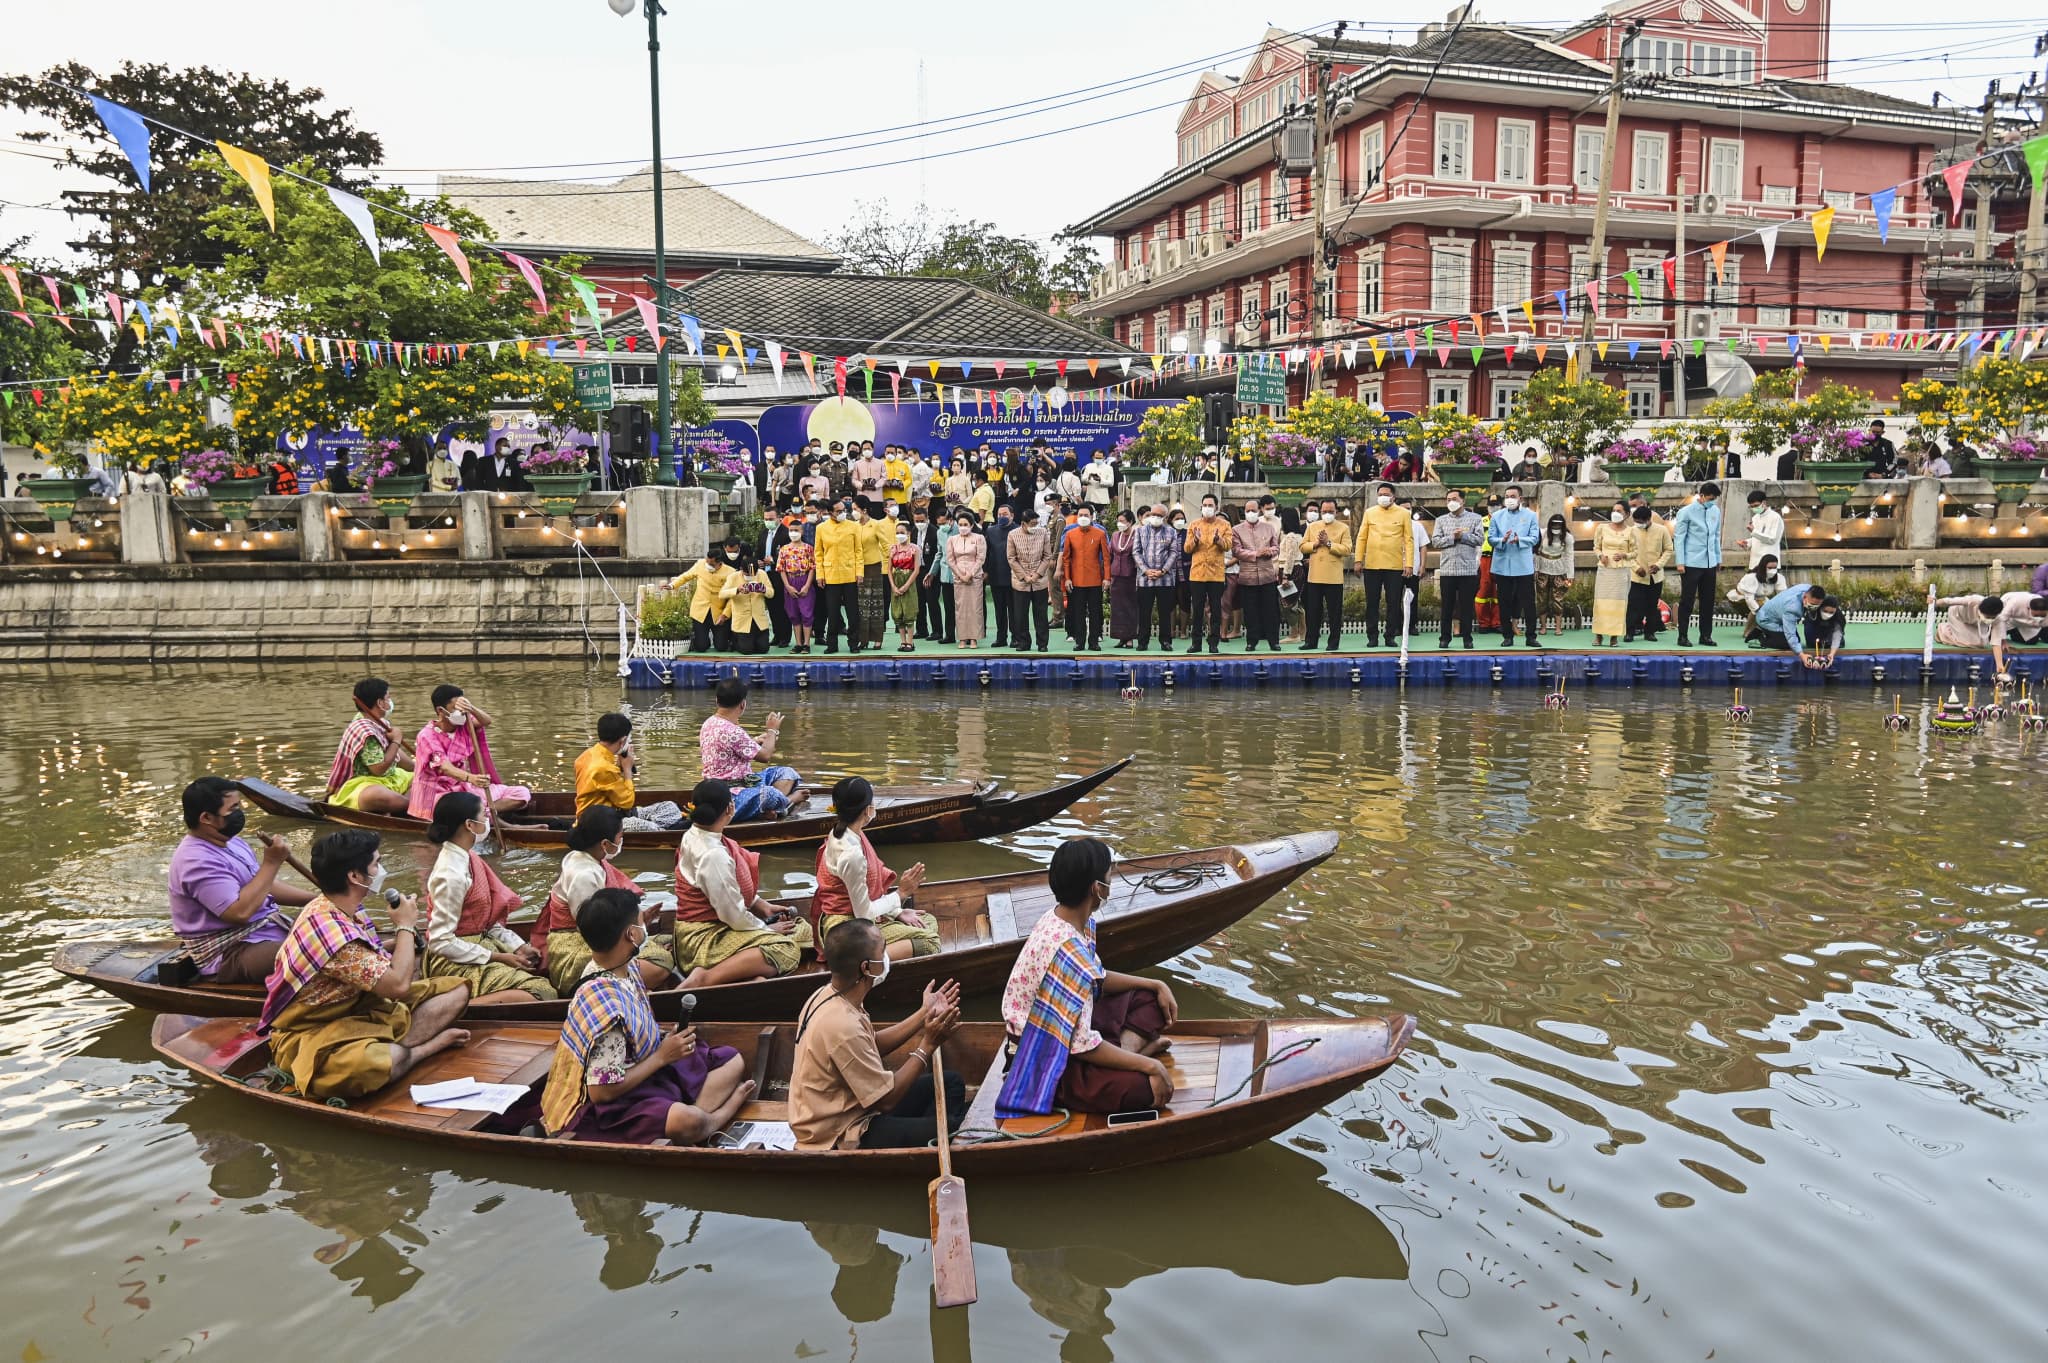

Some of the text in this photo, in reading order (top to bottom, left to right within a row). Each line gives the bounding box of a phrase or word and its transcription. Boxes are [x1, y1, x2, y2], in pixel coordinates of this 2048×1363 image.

[1266, 387, 1284, 395] 19.30
[932, 409, 1031, 428] ลอยกระทงวิถใหม่
